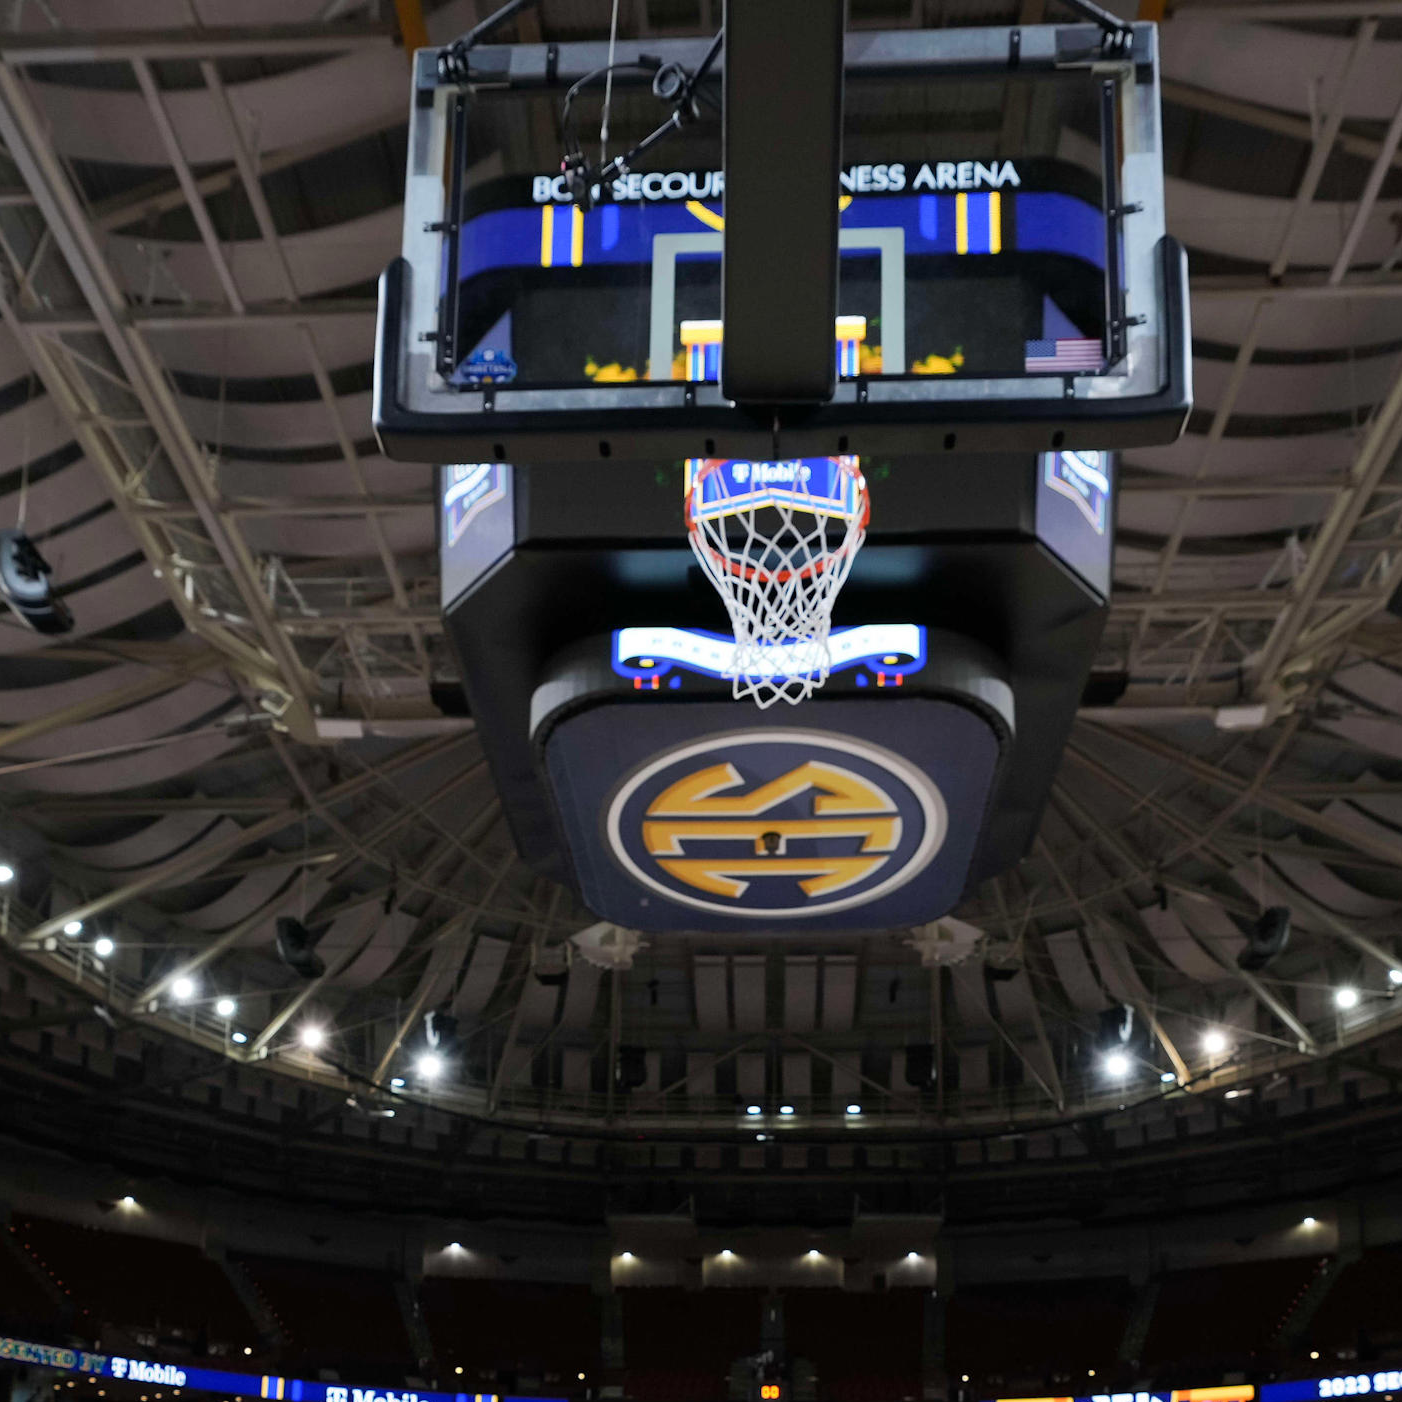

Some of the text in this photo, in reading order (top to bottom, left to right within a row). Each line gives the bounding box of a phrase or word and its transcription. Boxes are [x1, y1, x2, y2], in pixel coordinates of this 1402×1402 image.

[533, 175, 599, 202] BO
[611, 170, 725, 201] SECOUR
[912, 160, 1022, 190] ARENA
[128, 1358, 187, 1387] Mobile
[1318, 1373, 1371, 1398] 2023
